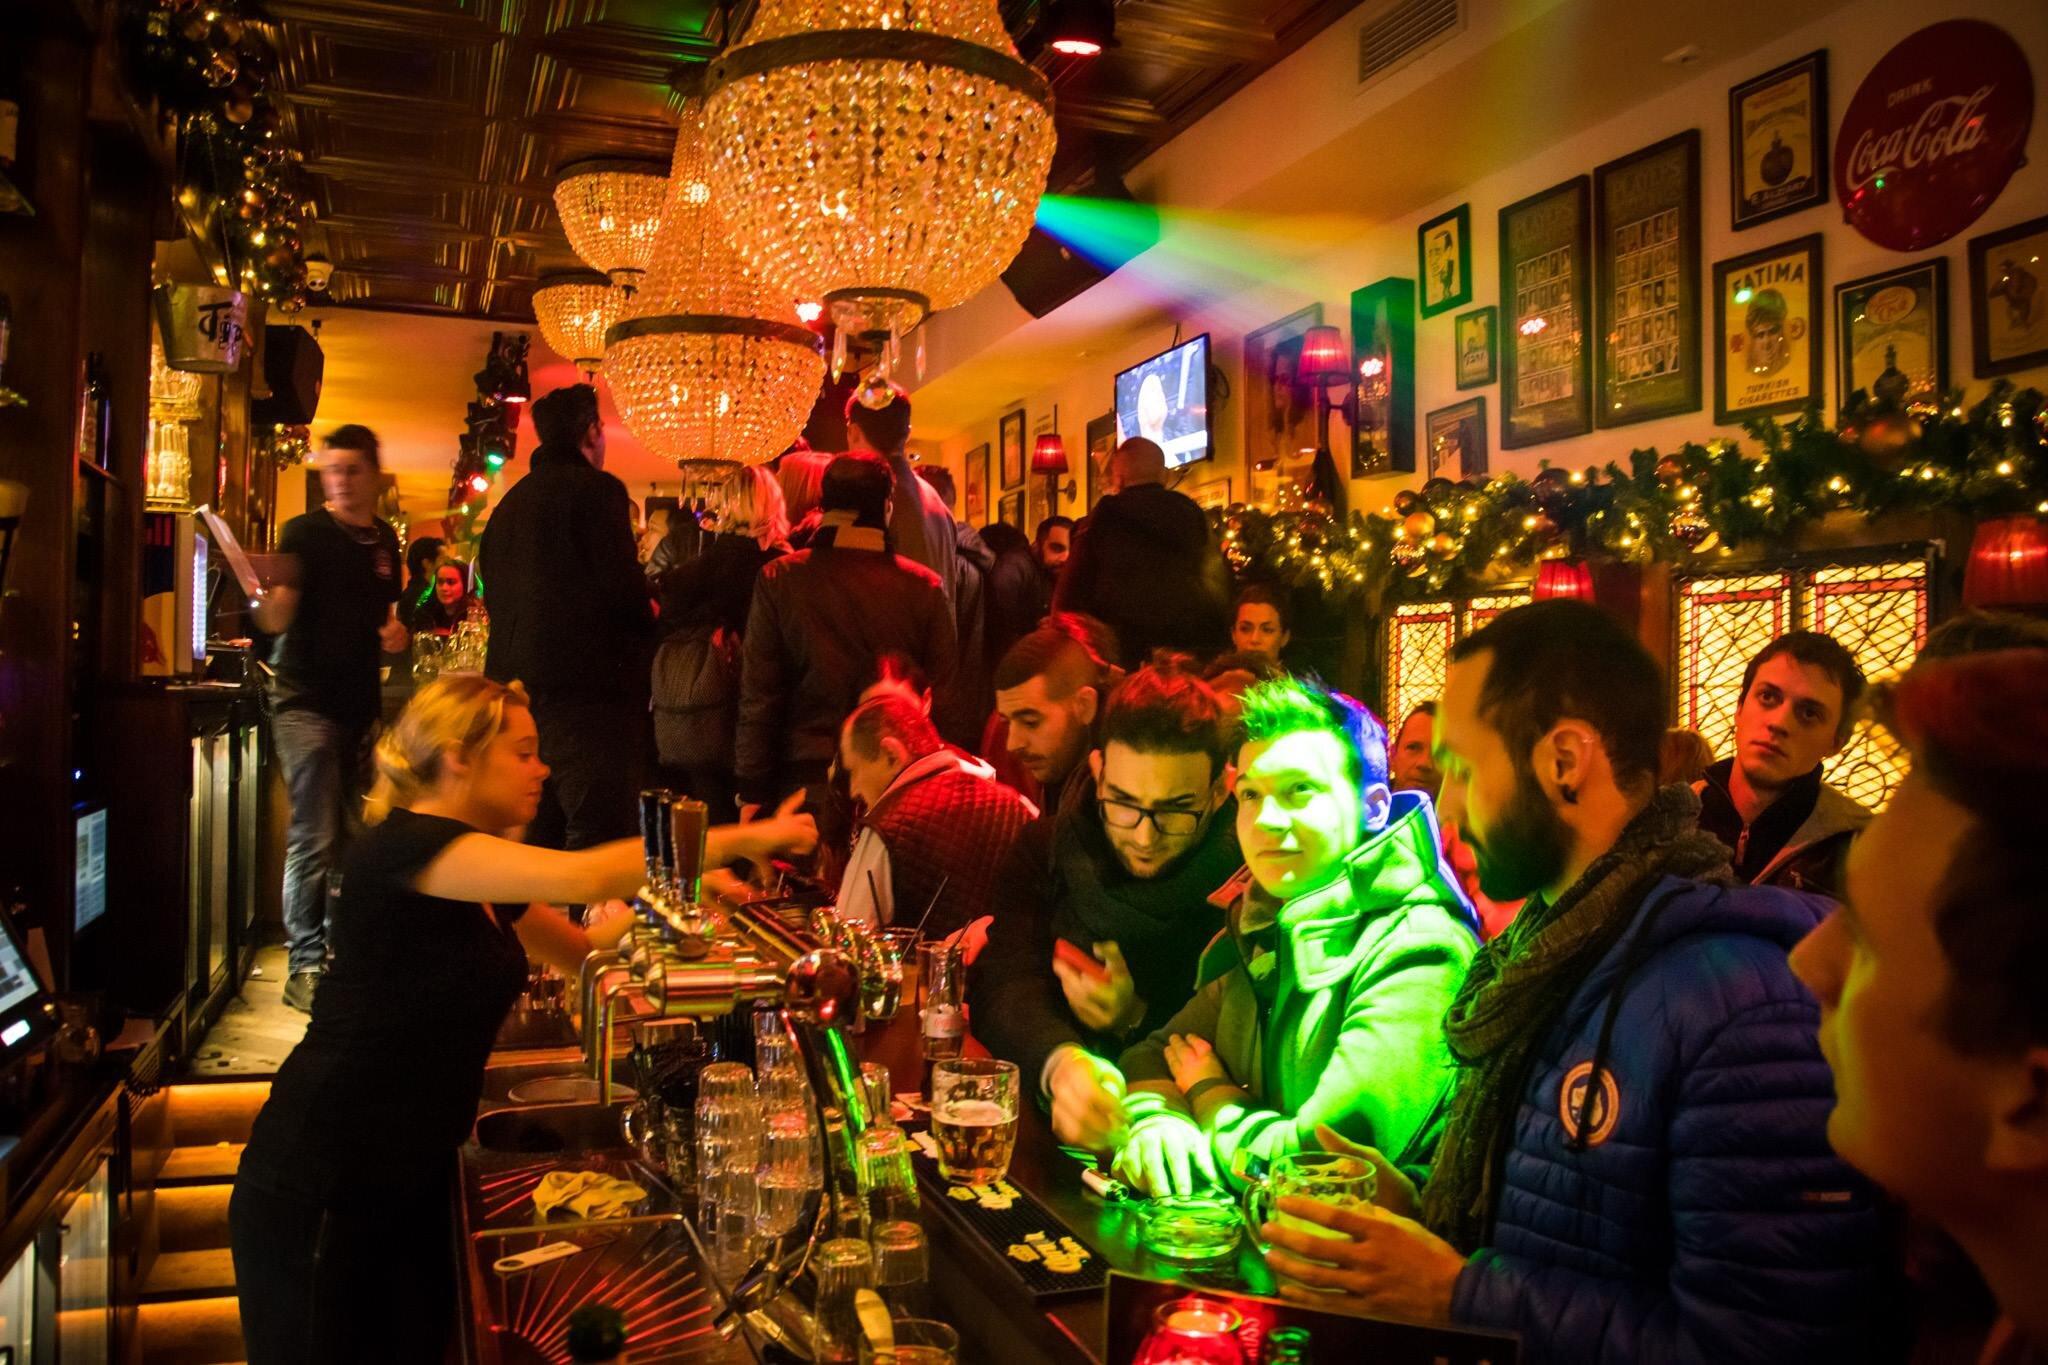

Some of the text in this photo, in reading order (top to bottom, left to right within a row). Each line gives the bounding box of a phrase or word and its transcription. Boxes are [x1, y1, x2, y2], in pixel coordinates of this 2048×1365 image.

[1887, 76, 1933, 108] DRINK
[1846, 82, 1998, 191] Coca-Cola
[1732, 262, 1804, 294] FATIMA
[1737, 385, 1801, 407] CIGARETTES
[1746, 378, 1790, 394] TURKISH
